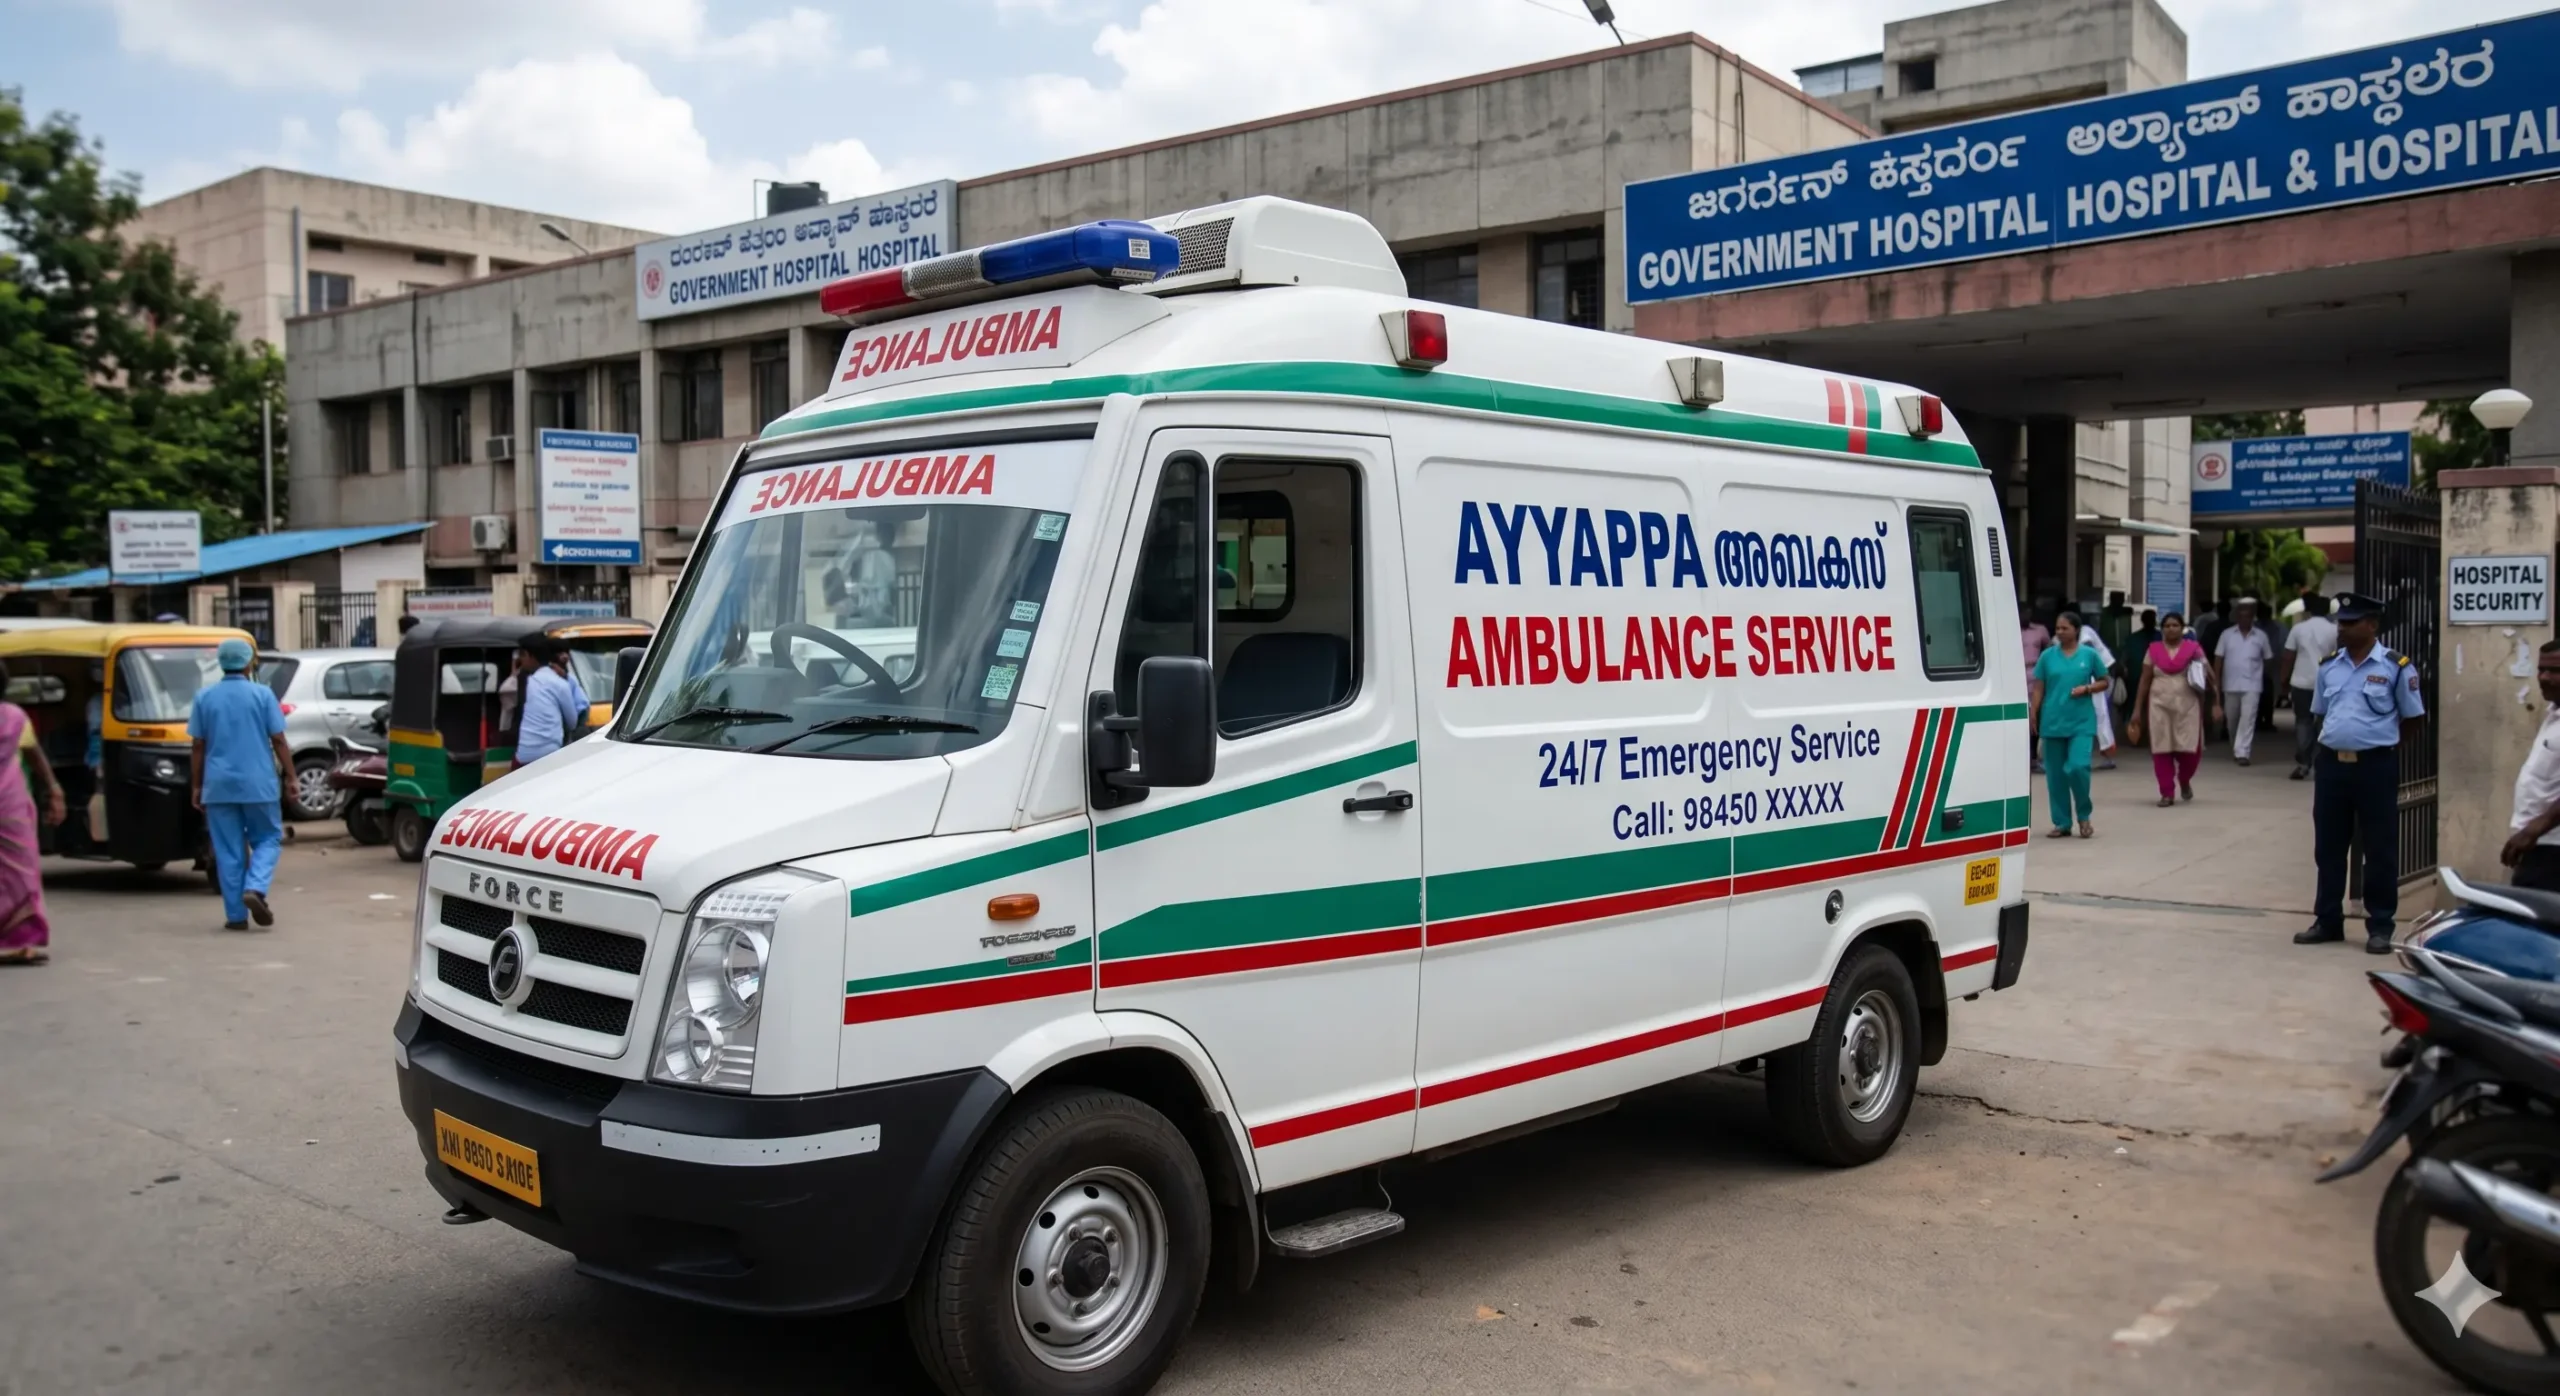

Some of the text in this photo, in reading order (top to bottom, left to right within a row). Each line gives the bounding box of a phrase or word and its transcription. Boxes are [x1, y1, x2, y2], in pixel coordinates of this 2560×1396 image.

[1638, 104, 2560, 289] GOVERNMENT HOSPITAL HOSPITAL & HOSPITAL
[669, 233, 941, 305] GOVERNMENT HOSPITAL HOSPITAL
[1454, 501, 1708, 588] AYYAPPA
[2453, 565, 2543, 584] HOSPITAL
[2453, 592, 2544, 611] SECURITY
[1446, 615, 1896, 688] AMBULANCE SERVICE
[1538, 721, 1880, 788] 24/7 Emergency Service
[1612, 781, 1845, 840] Call: 98450 XXXXX
[469, 872, 564, 914] FORCE
